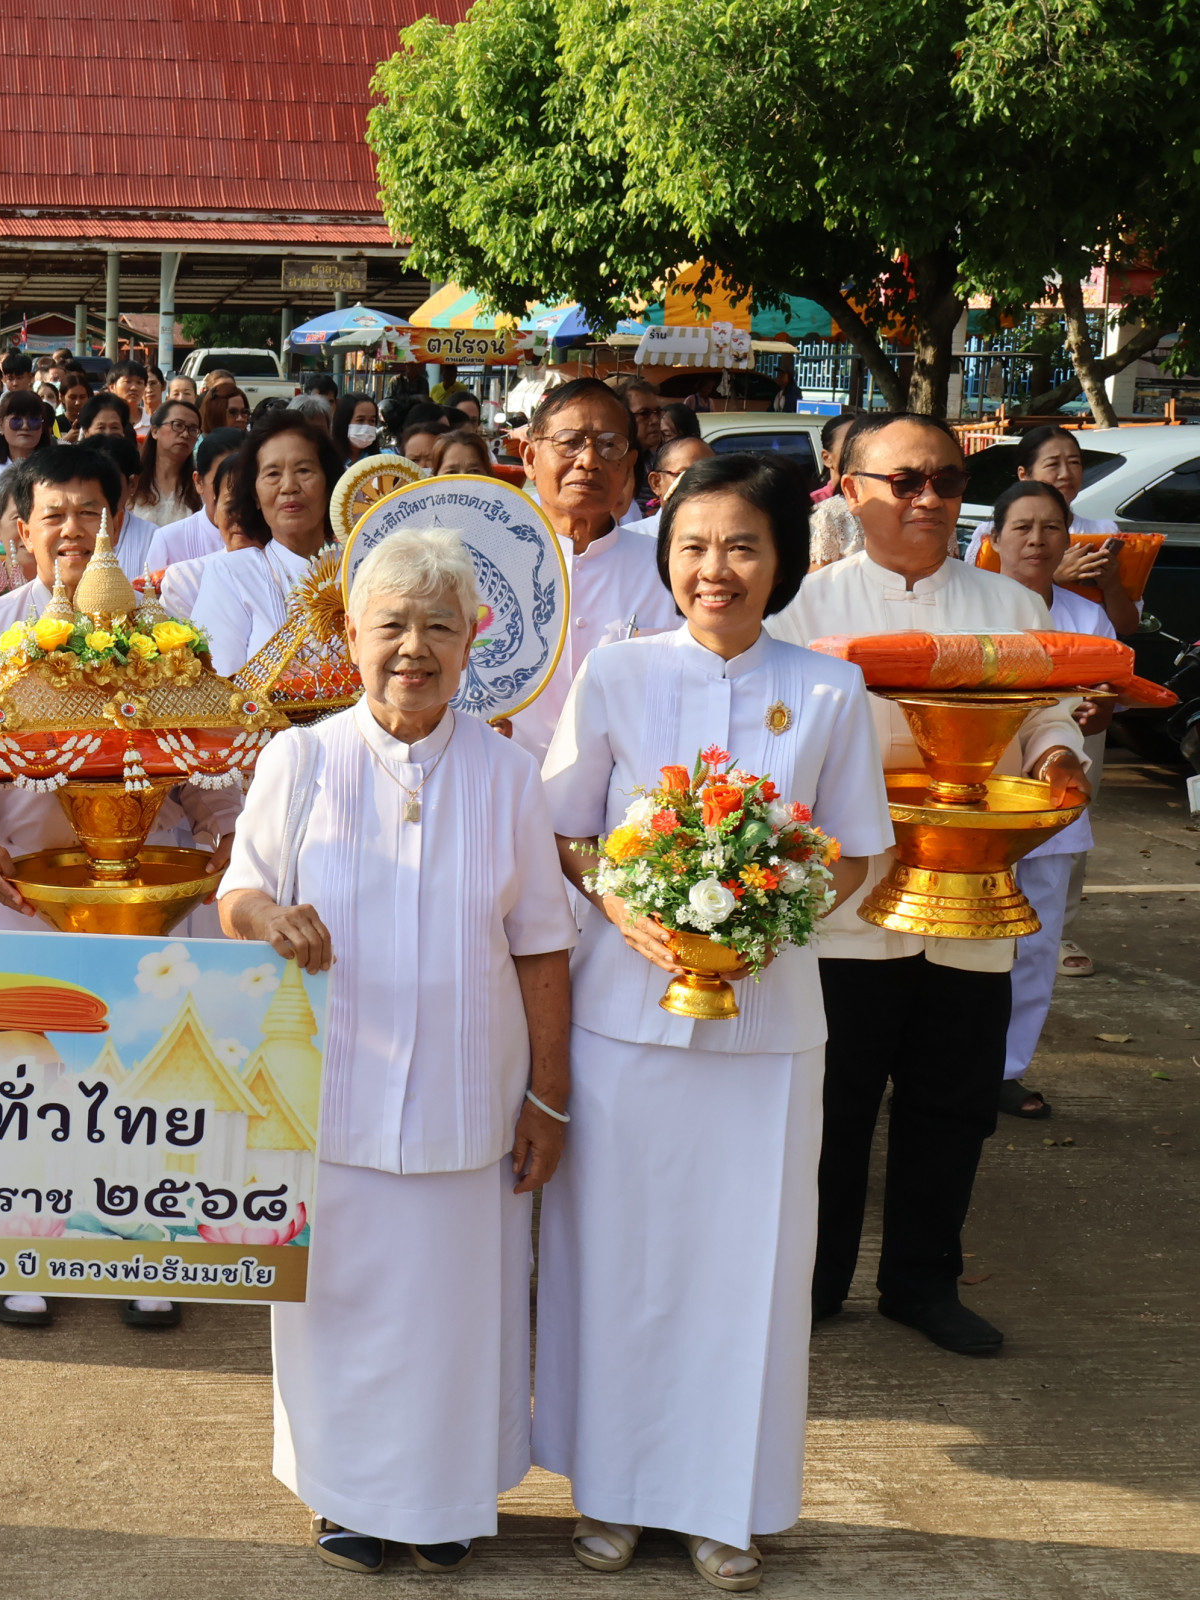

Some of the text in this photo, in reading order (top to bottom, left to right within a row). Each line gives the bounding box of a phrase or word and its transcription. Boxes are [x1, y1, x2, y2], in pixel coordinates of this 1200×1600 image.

[427, 329, 505, 355] ตาโรจน์
[649, 328, 667, 340] ร้าน
[93, 1175, 288, 1222] ๒๕๖๘
[18, 1252, 36, 1276] ปี
[49, 1257, 272, 1284] หลวงพ่อธัมมชโย
